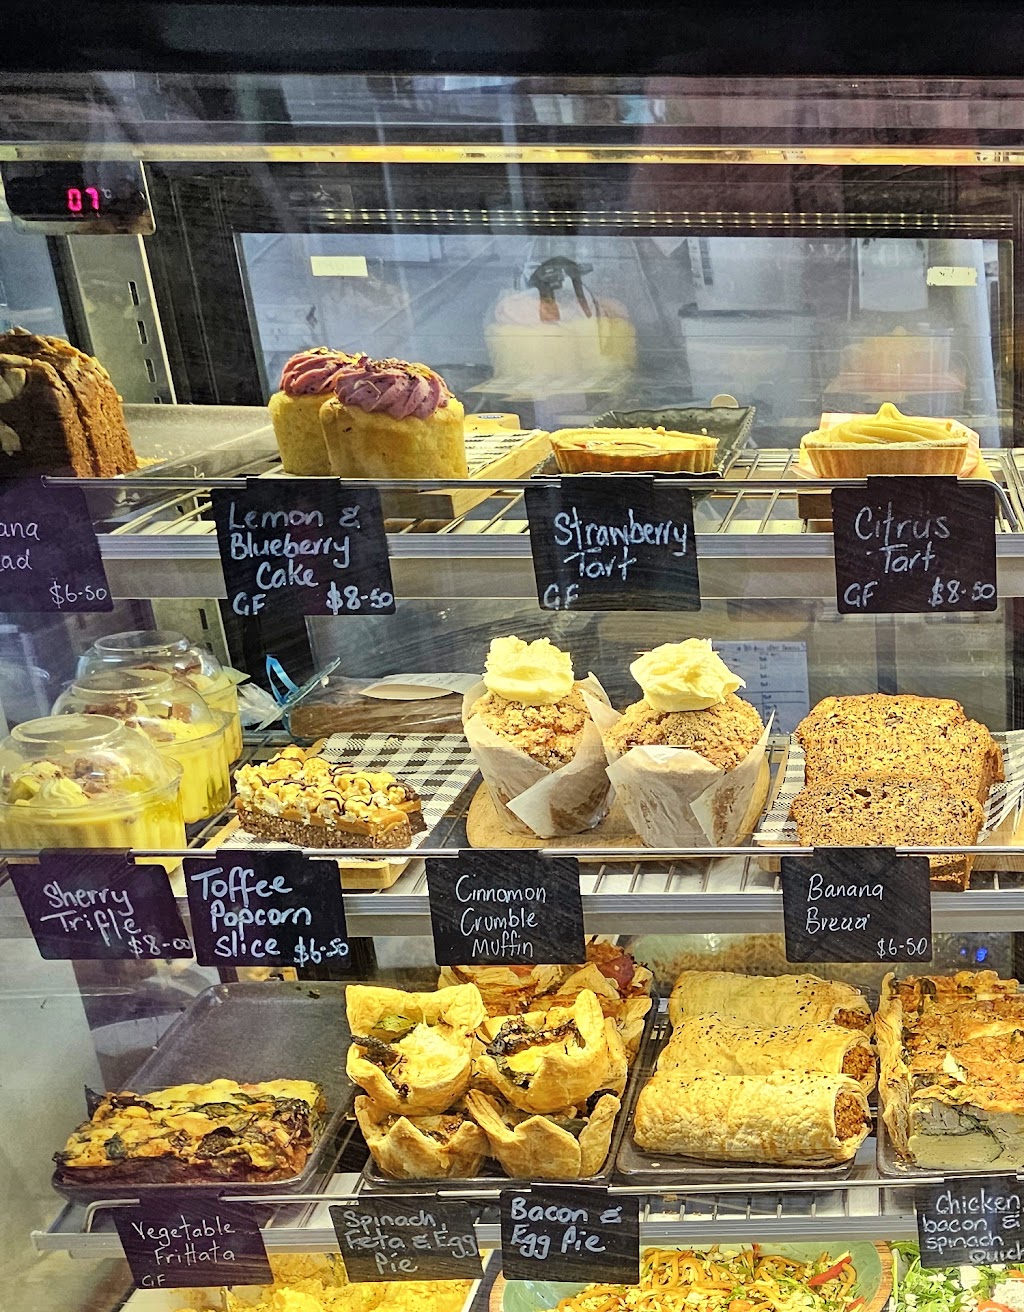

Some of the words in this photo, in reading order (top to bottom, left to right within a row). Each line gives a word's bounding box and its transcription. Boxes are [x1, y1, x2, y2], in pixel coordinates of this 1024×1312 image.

[67, 187, 99, 211] 07
[229, 502, 324, 530] Lemon
[339, 505, 361, 529] &
[855, 501, 950, 546] Citrus
[554, 506, 688, 557] Strawberry
[0, 549, 32, 572] ad
[230, 531, 350, 569] Blueberry
[564, 545, 637, 581] Tart
[877, 541, 936, 574] Tart
[256, 559, 319, 590] Cake
[232, 591, 267, 616] GF
[543, 583, 579, 611] GF
[843, 581, 878, 608] GF
[43, 881, 134, 916] Sherry
[191, 866, 293, 907] Toffee
[455, 874, 546, 903] Cinnamon
[807, 873, 884, 902] Banana
[40, 909, 142, 946] Trifle
[210, 900, 312, 941] Popcorn
[460, 907, 538, 936] Crumble
[806, 906, 871, 934] Bread
[472, 930, 534, 957] Muffin
[511, 1196, 588, 1222] Bacon
[922, 1213, 988, 1233] bacon
[131, 1214, 236, 1247] Vegetable
[343, 1227, 405, 1250] Feta
[433, 1229, 478, 1259] Egg
[510, 1223, 551, 1260] Egg
[561, 1225, 606, 1254] Pie
[926, 1230, 1004, 1255] spinach
[154, 1240, 236, 1266] Frittata
[375, 1251, 418, 1275] Pie
[141, 1274, 166, 1287] GF
